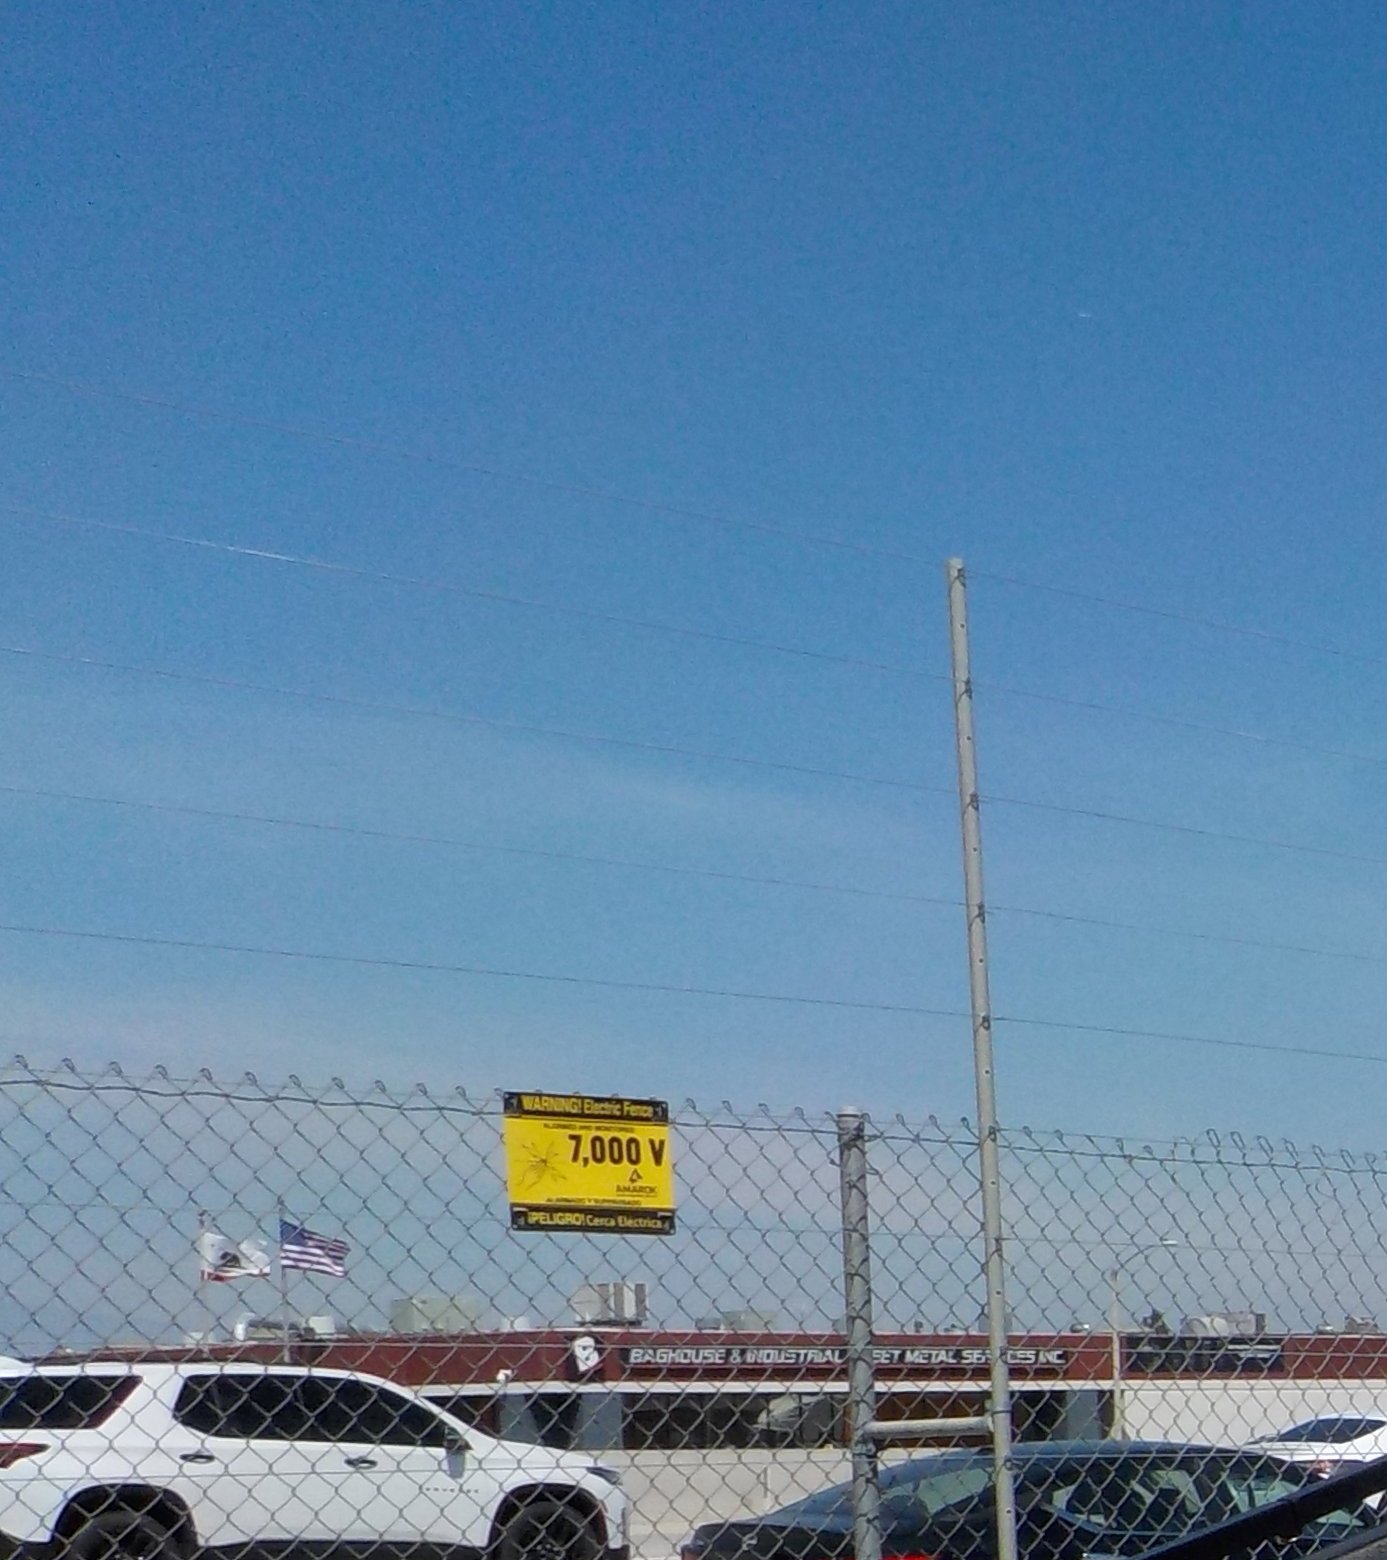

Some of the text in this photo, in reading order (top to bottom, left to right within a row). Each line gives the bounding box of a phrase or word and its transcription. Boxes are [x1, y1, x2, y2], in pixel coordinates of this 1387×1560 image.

[521, 1095, 653, 1117] WARNING! Electric Fence
[568, 1134, 665, 1167] 7,000 V
[587, 1215, 615, 1227] Cerca
[629, 1349, 725, 1364] BAGHOUSE
[729, 1349, 741, 1364] &
[746, 1349, 844, 1364] INDUSTRIAL
[904, 1349, 957, 1364] METAL
